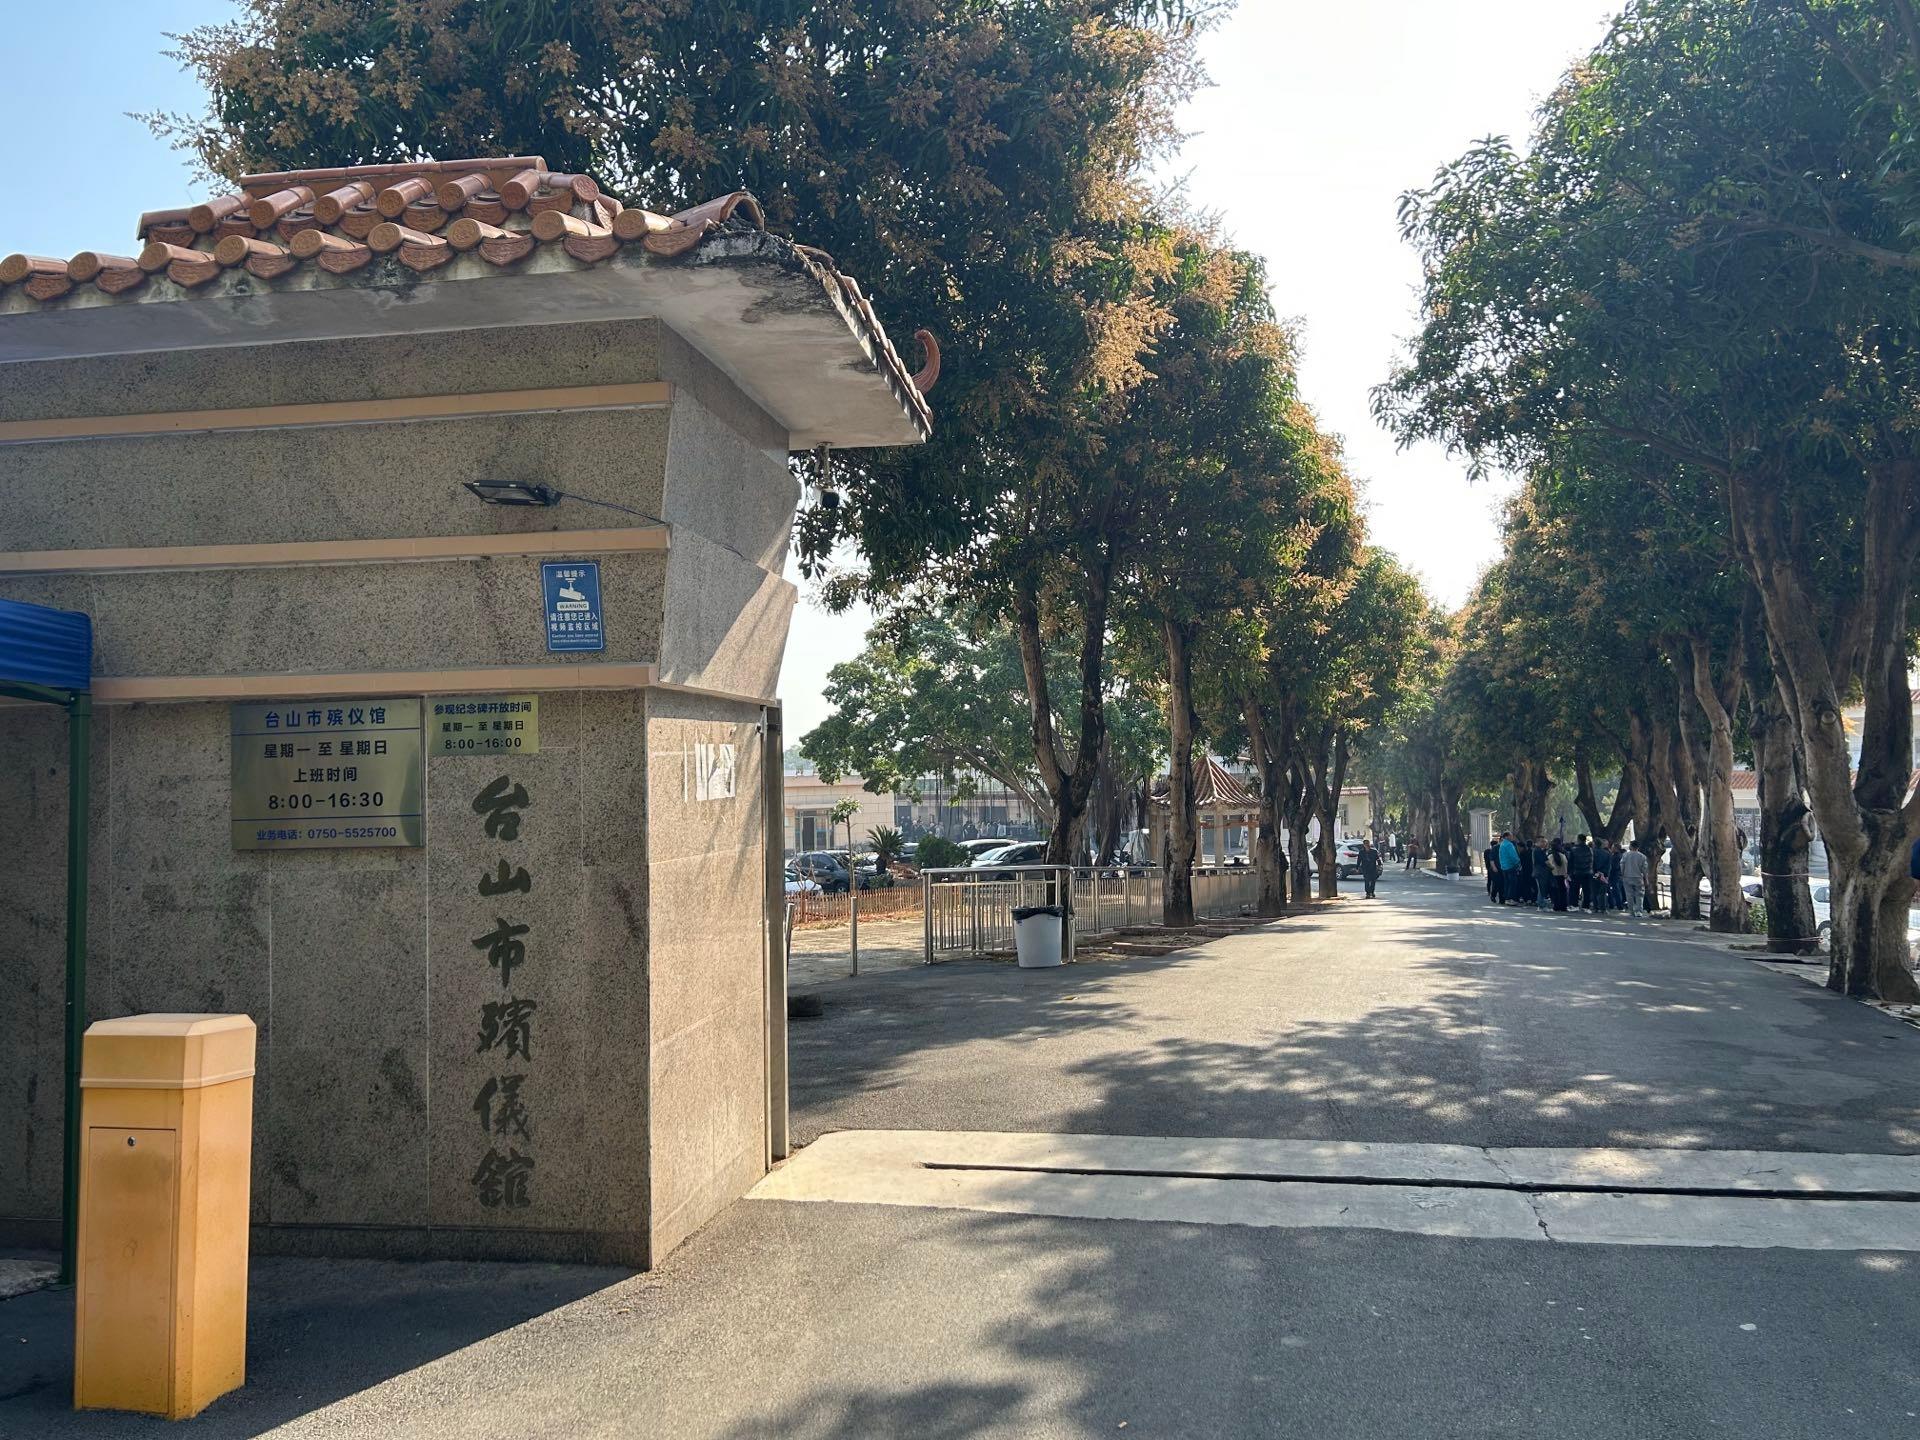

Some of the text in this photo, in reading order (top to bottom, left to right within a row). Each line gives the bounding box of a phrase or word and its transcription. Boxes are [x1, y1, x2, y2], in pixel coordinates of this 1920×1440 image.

[434, 701, 532, 715] 参观纪念碑开放时间
[264, 706, 387, 728] 台山市殡仪馆
[444, 737, 522, 749] 8:00-16:00
[292, 766, 358, 783] 上班时间
[268, 791, 384, 810] 8:00-16:30
